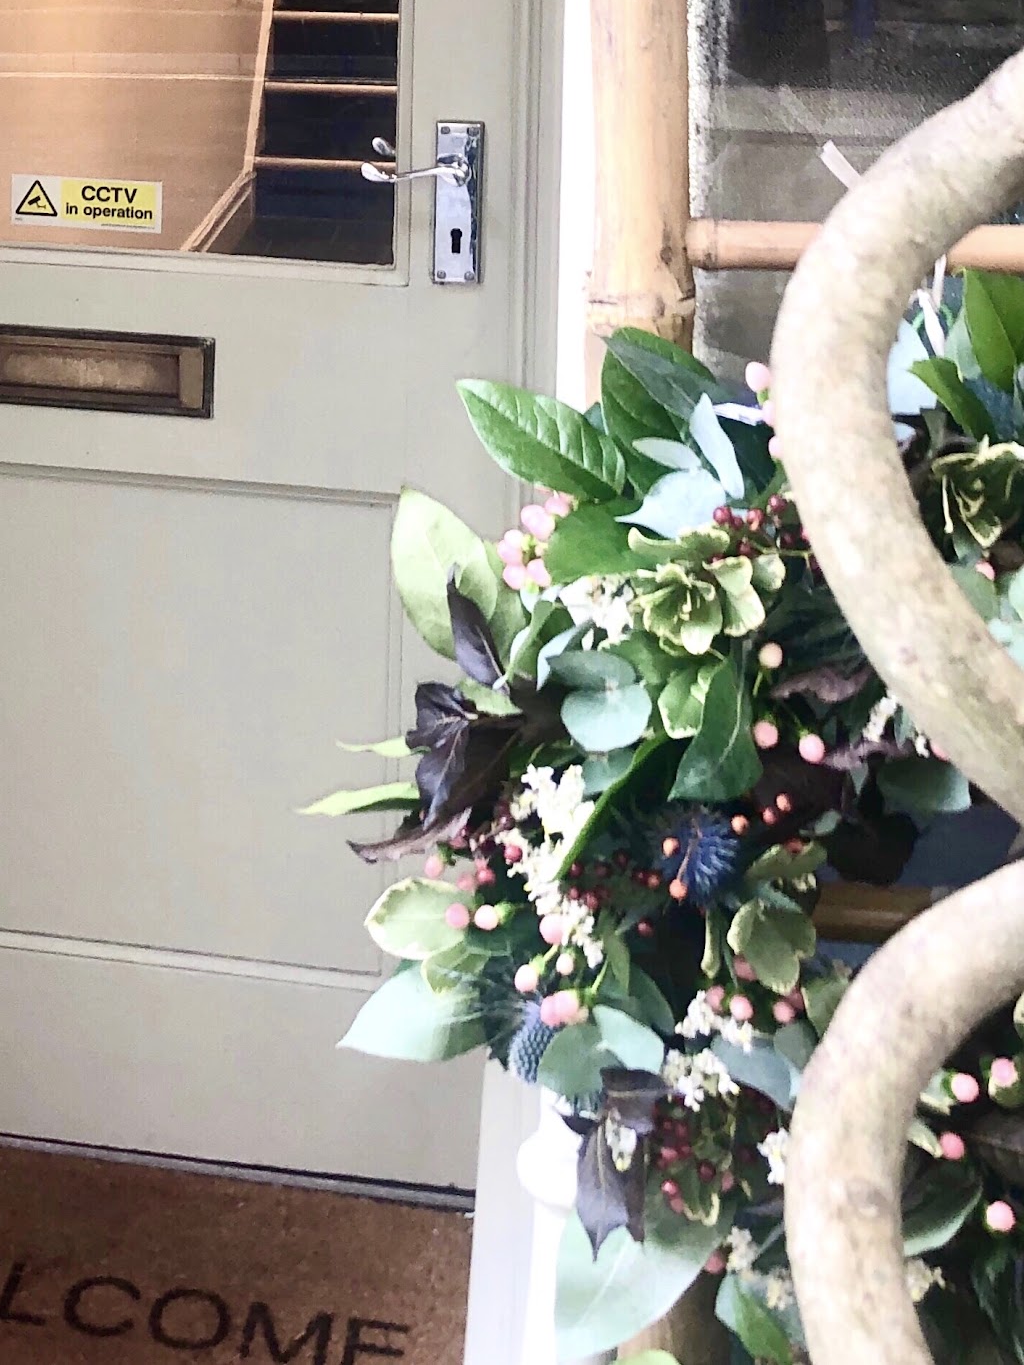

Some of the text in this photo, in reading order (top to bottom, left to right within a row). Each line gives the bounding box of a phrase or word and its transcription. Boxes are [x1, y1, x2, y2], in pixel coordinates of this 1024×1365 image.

[81, 185, 137, 204] CCTV
[65, 202, 153, 220] in operation
